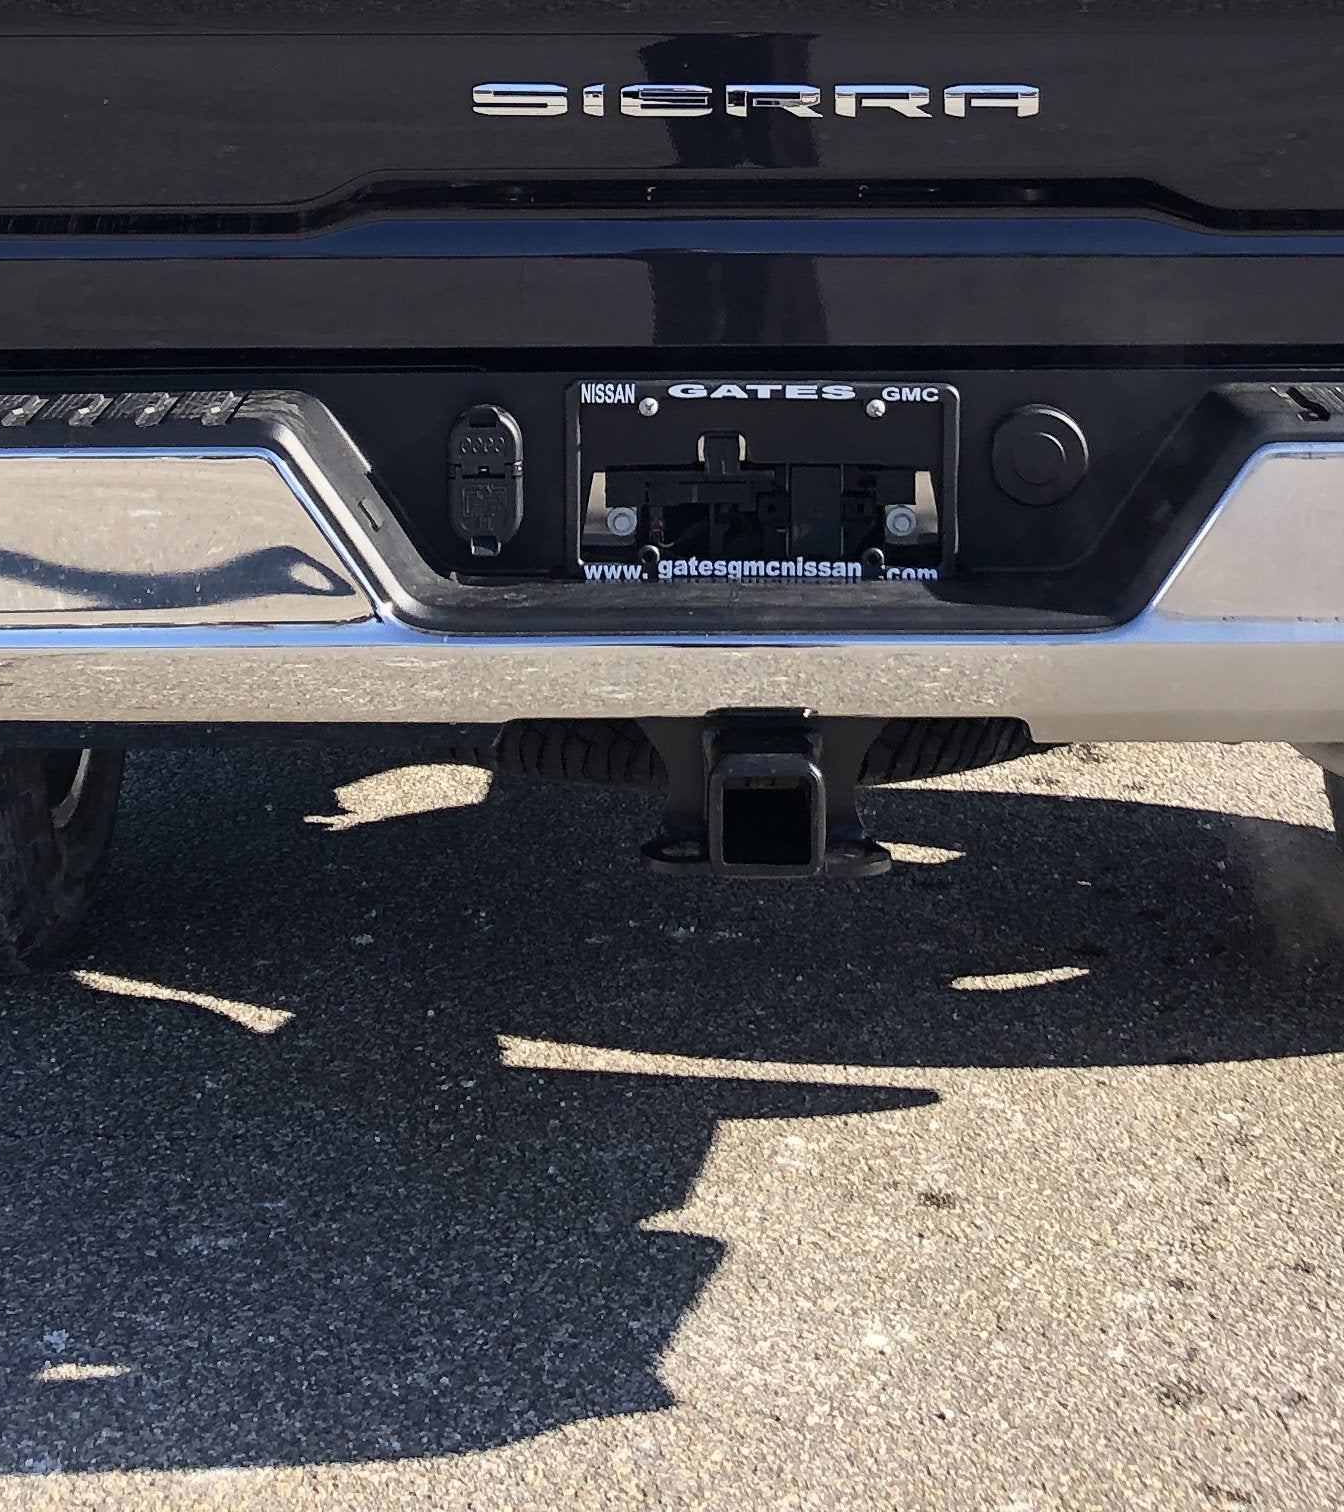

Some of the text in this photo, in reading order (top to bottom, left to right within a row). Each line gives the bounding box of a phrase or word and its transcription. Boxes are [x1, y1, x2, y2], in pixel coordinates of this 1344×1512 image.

[472, 83, 1041, 119] SIERRA
[581, 383, 940, 404] NISSAN GATES GMC
